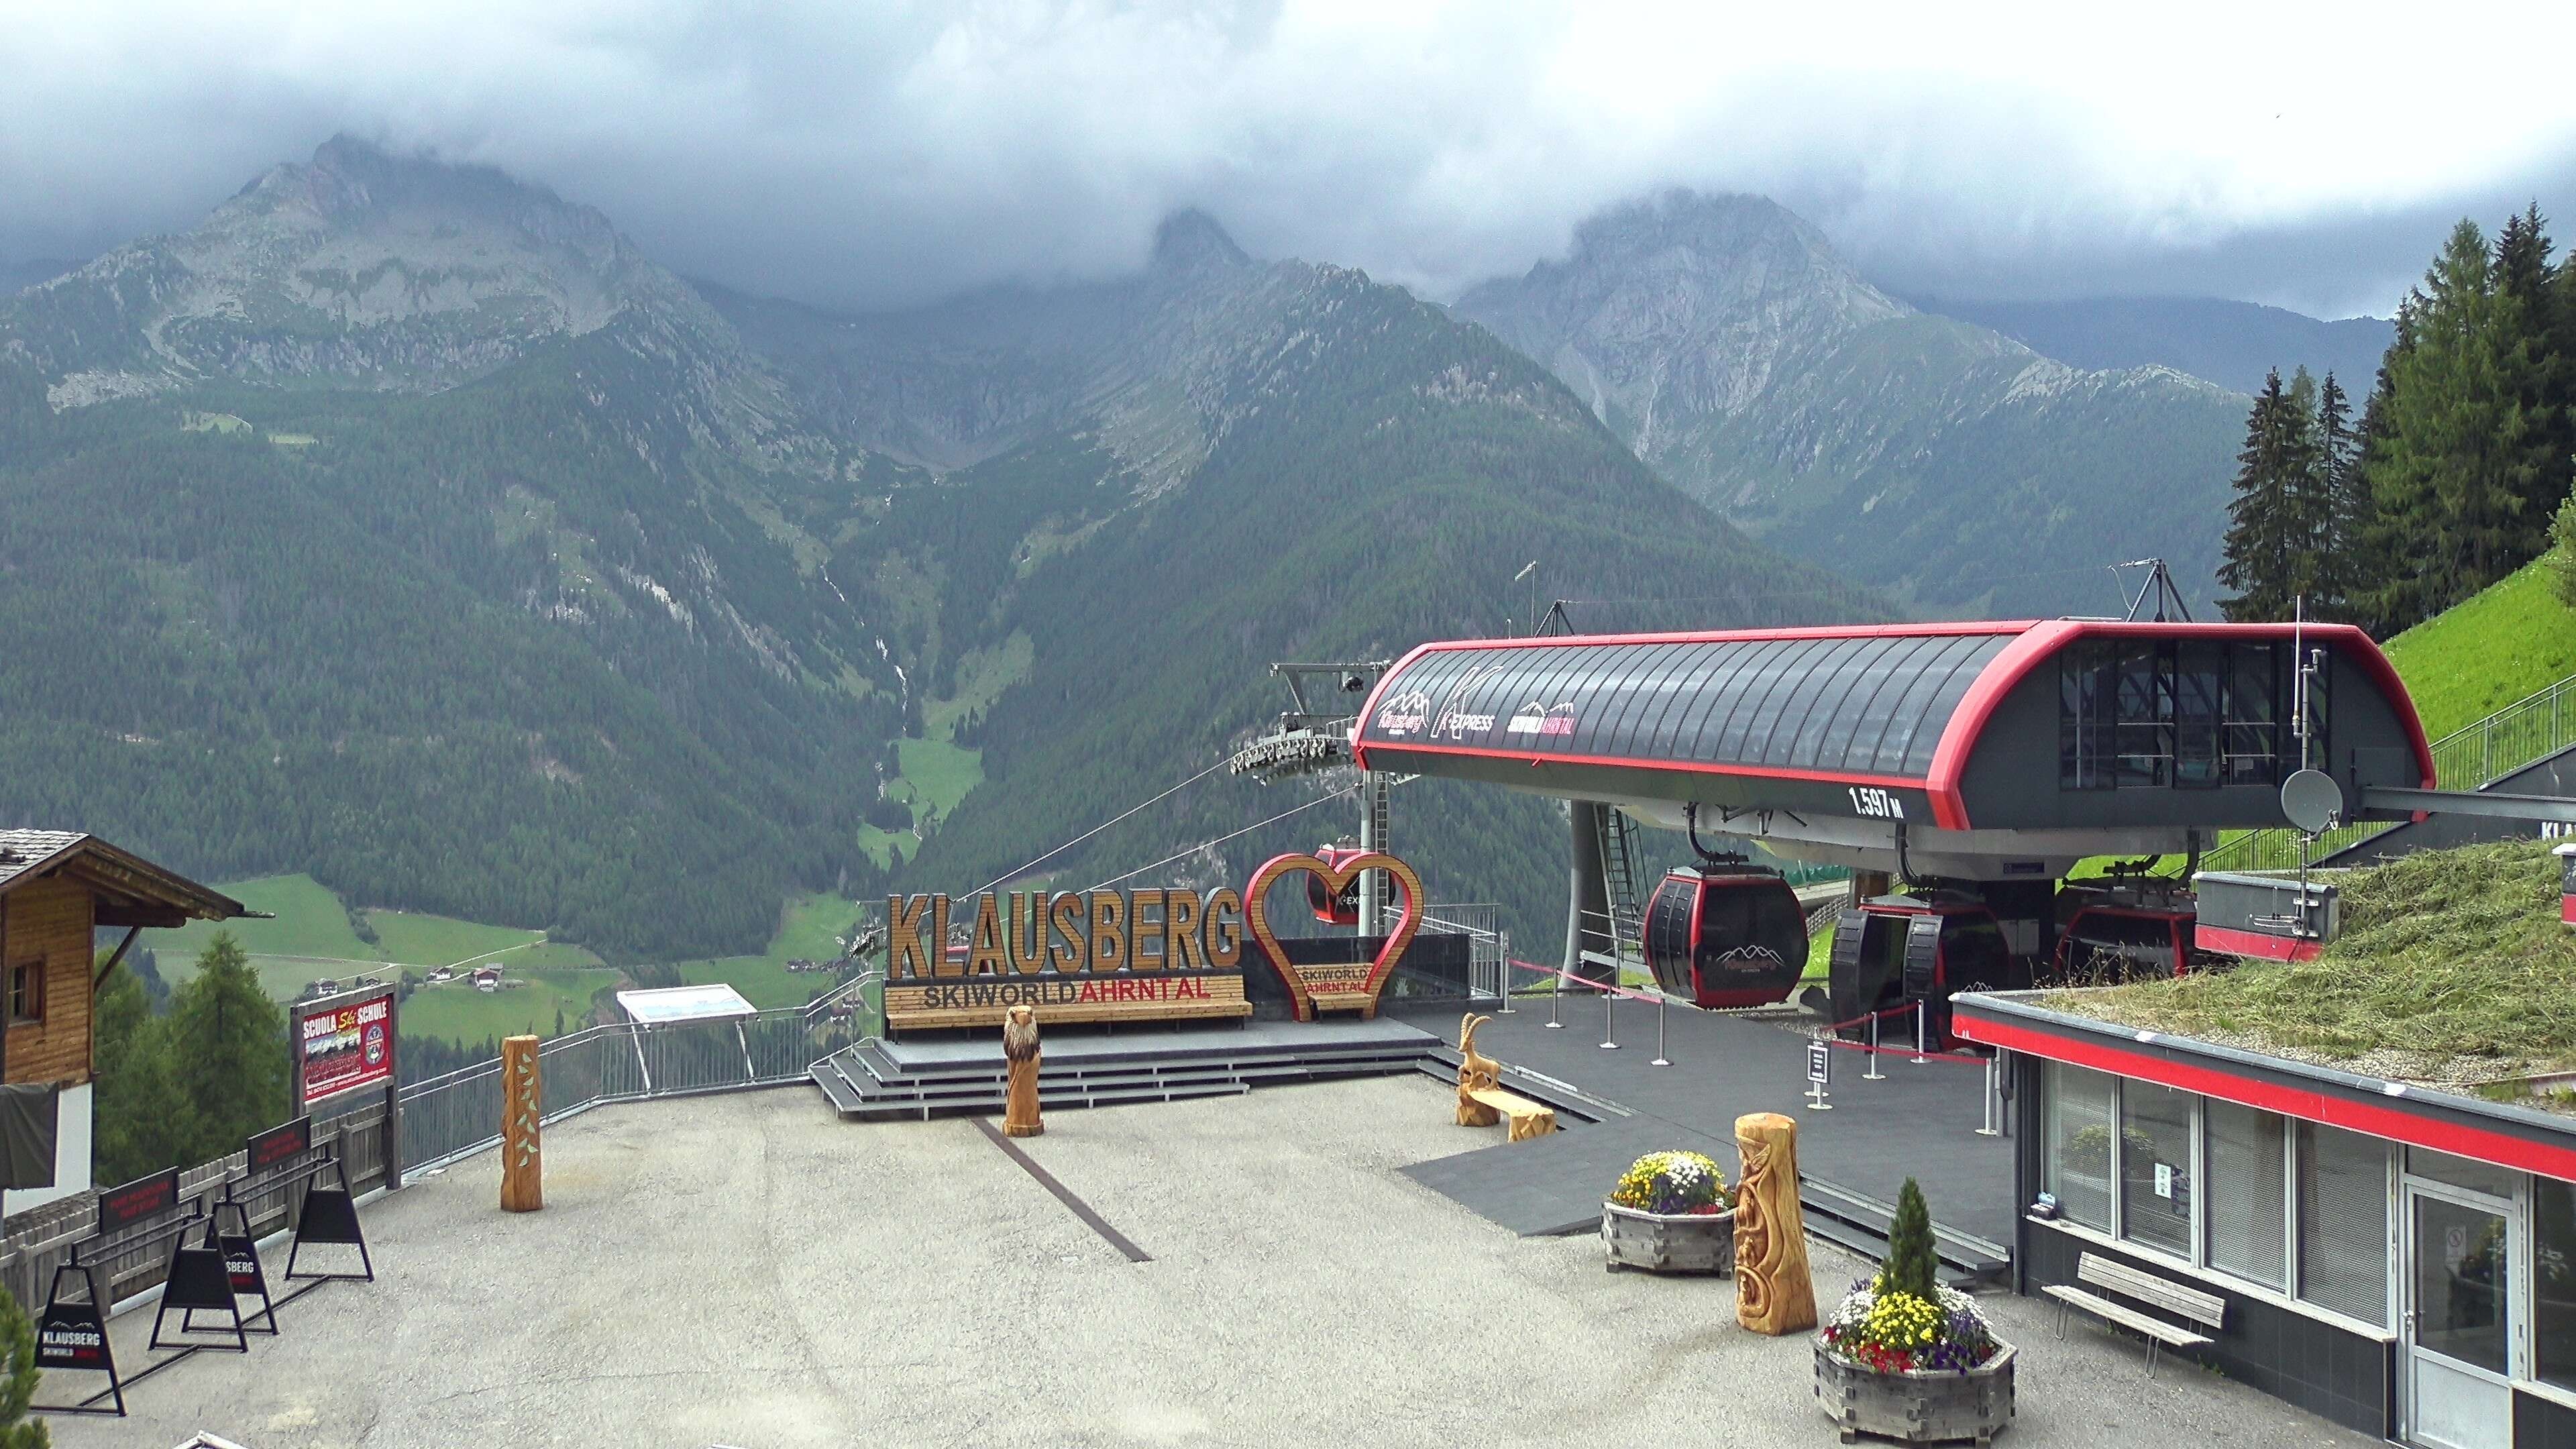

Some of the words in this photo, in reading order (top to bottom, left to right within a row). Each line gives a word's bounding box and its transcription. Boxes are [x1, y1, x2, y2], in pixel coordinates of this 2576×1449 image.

[1849, 787, 1890, 817] 1.597
[887, 887, 1242, 979] KLAUSBERG
[1303, 969, 1368, 981] SKIWORLD
[1307, 981, 1364, 992] AHRNTAL
[303, 1014, 337, 1039] SCUOLA
[358, 1001, 387, 1025] SCHULE
[226, 1261, 254, 1273] SBERG
[43, 1331, 101, 1346] KLAUSBERG
